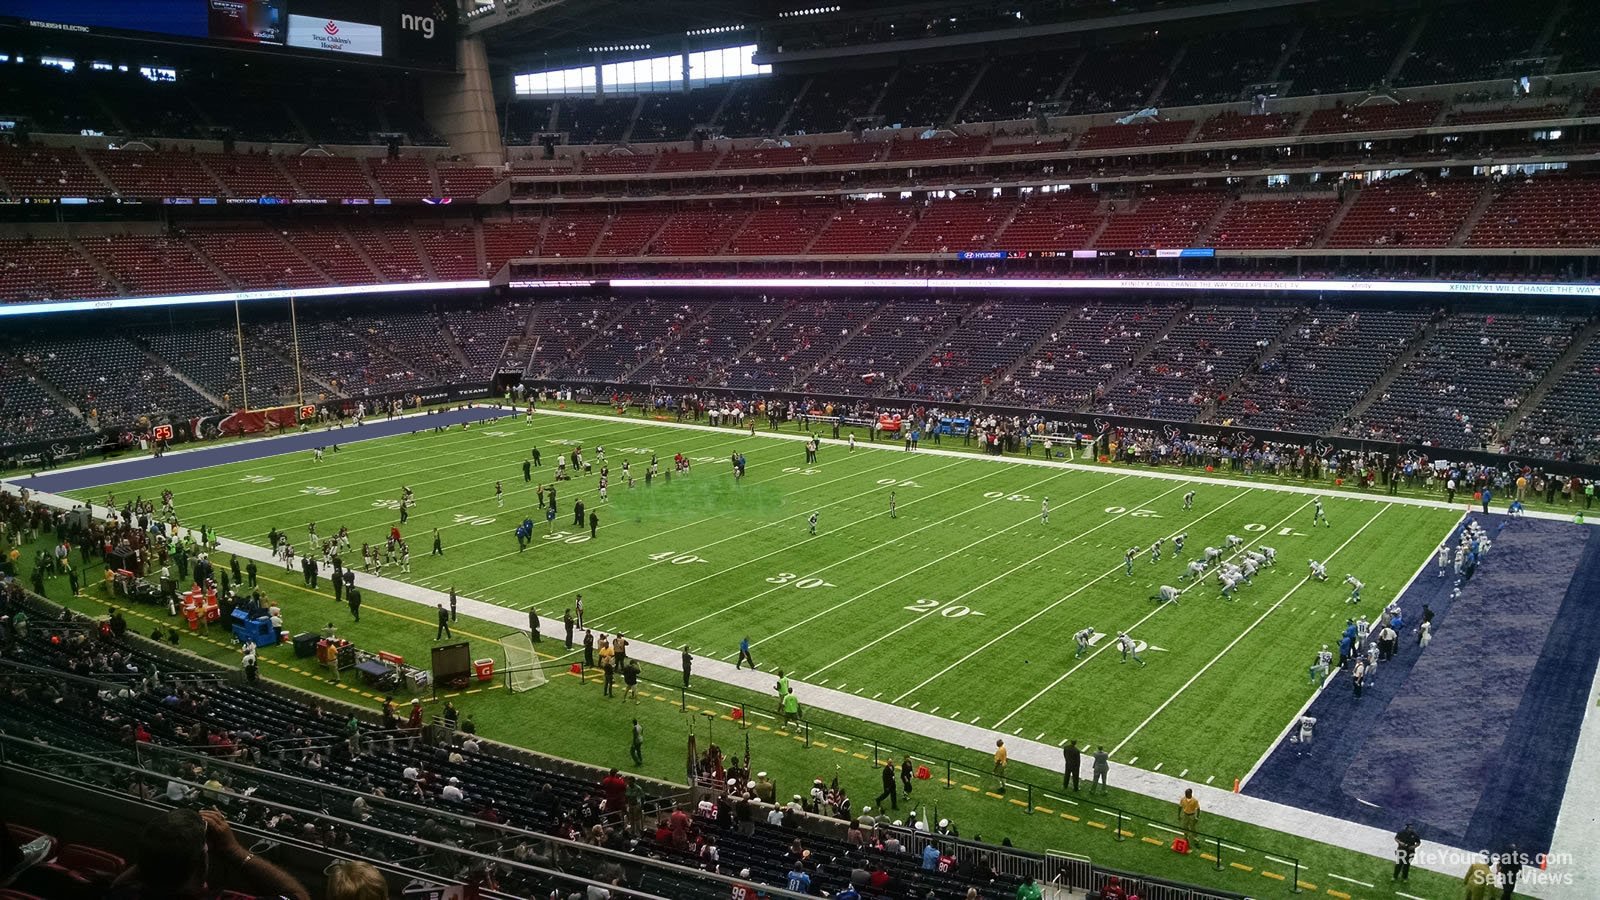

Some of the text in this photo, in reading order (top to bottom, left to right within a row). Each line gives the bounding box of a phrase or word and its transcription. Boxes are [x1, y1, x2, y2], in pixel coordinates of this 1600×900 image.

[30, 20, 90, 32] MITSUBISHI ELECTRIC
[401, 13, 435, 39] nrg
[327, 35, 352, 44] Children's
[321, 42, 343, 50] Hospital
[422, 392, 448, 400] TEXANS
[156, 427, 170, 439] 25
[542, 531, 591, 544] 50
[648, 551, 699, 565] 40
[765, 572, 824, 589] 30
[903, 599, 971, 618] 20
[481, 667, 491, 676] G
[731, 886, 747, 900] 99
